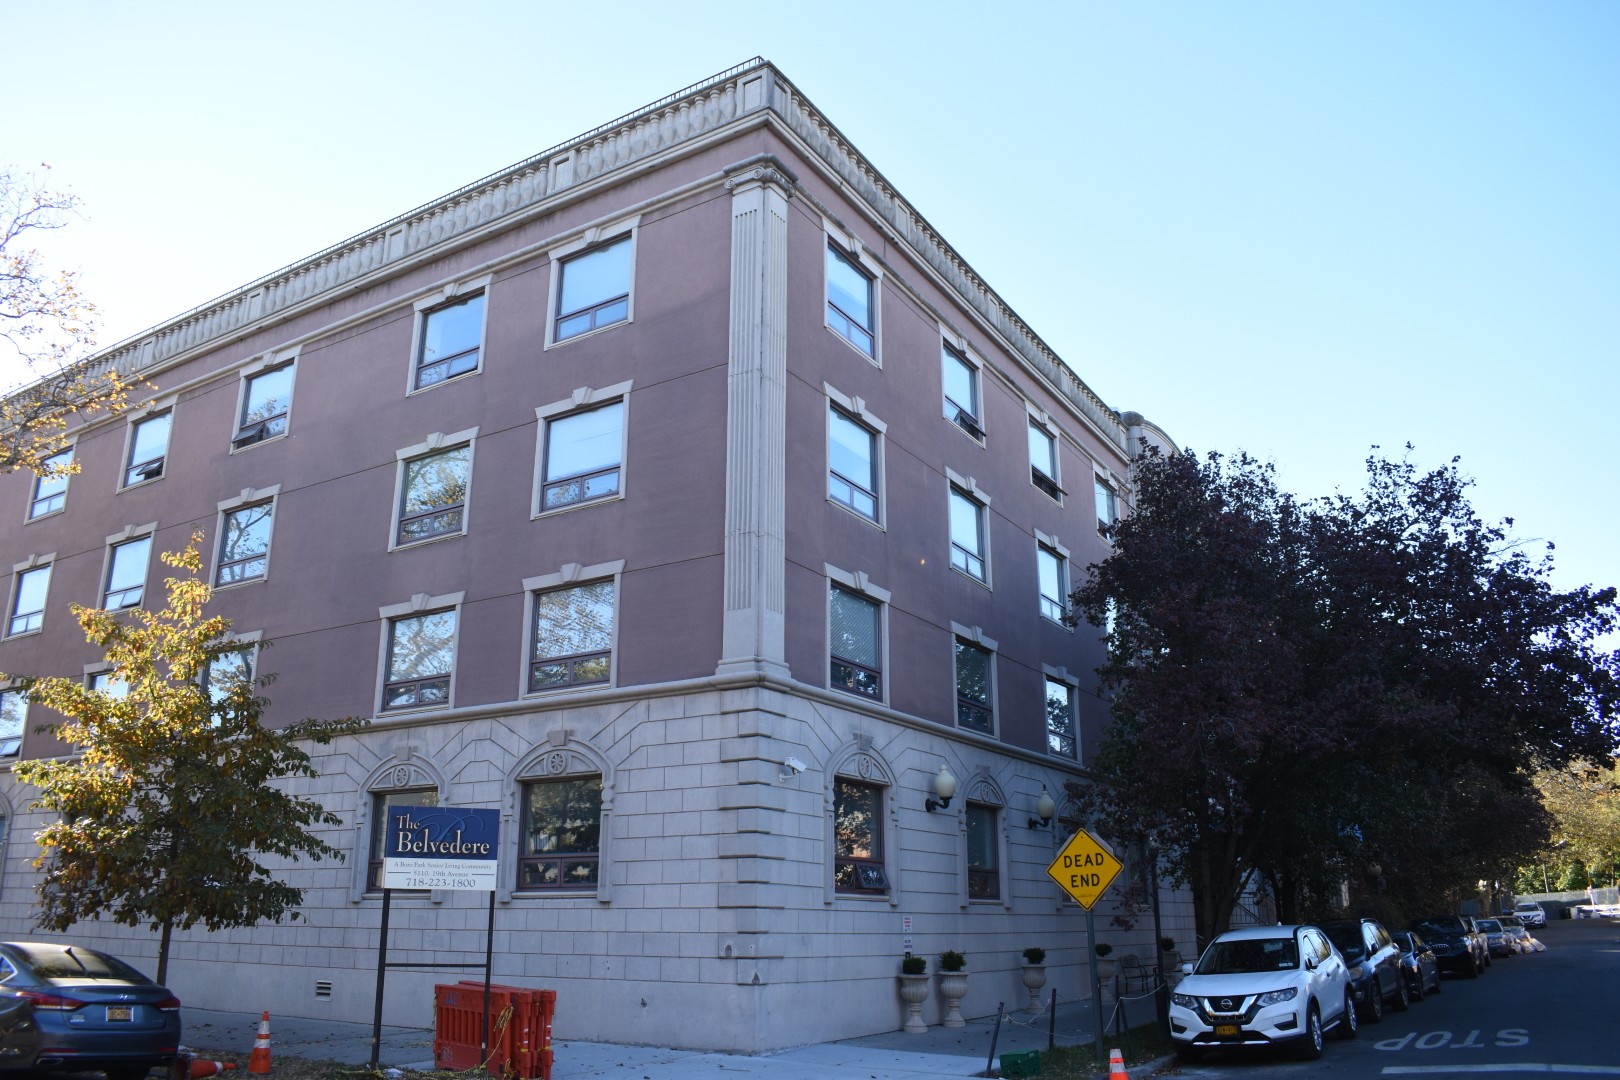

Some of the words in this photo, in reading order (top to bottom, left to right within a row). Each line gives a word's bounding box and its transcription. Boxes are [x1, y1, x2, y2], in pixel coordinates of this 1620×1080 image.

[396, 813, 420, 829] The
[396, 828, 490, 854] Belvedere
[461, 862, 492, 870] Community
[1063, 852, 1104, 868] DEAD
[406, 877, 476, 888] 718-223-1800
[1070, 873, 1100, 888] END
[1373, 1028, 1529, 1051] STOP
